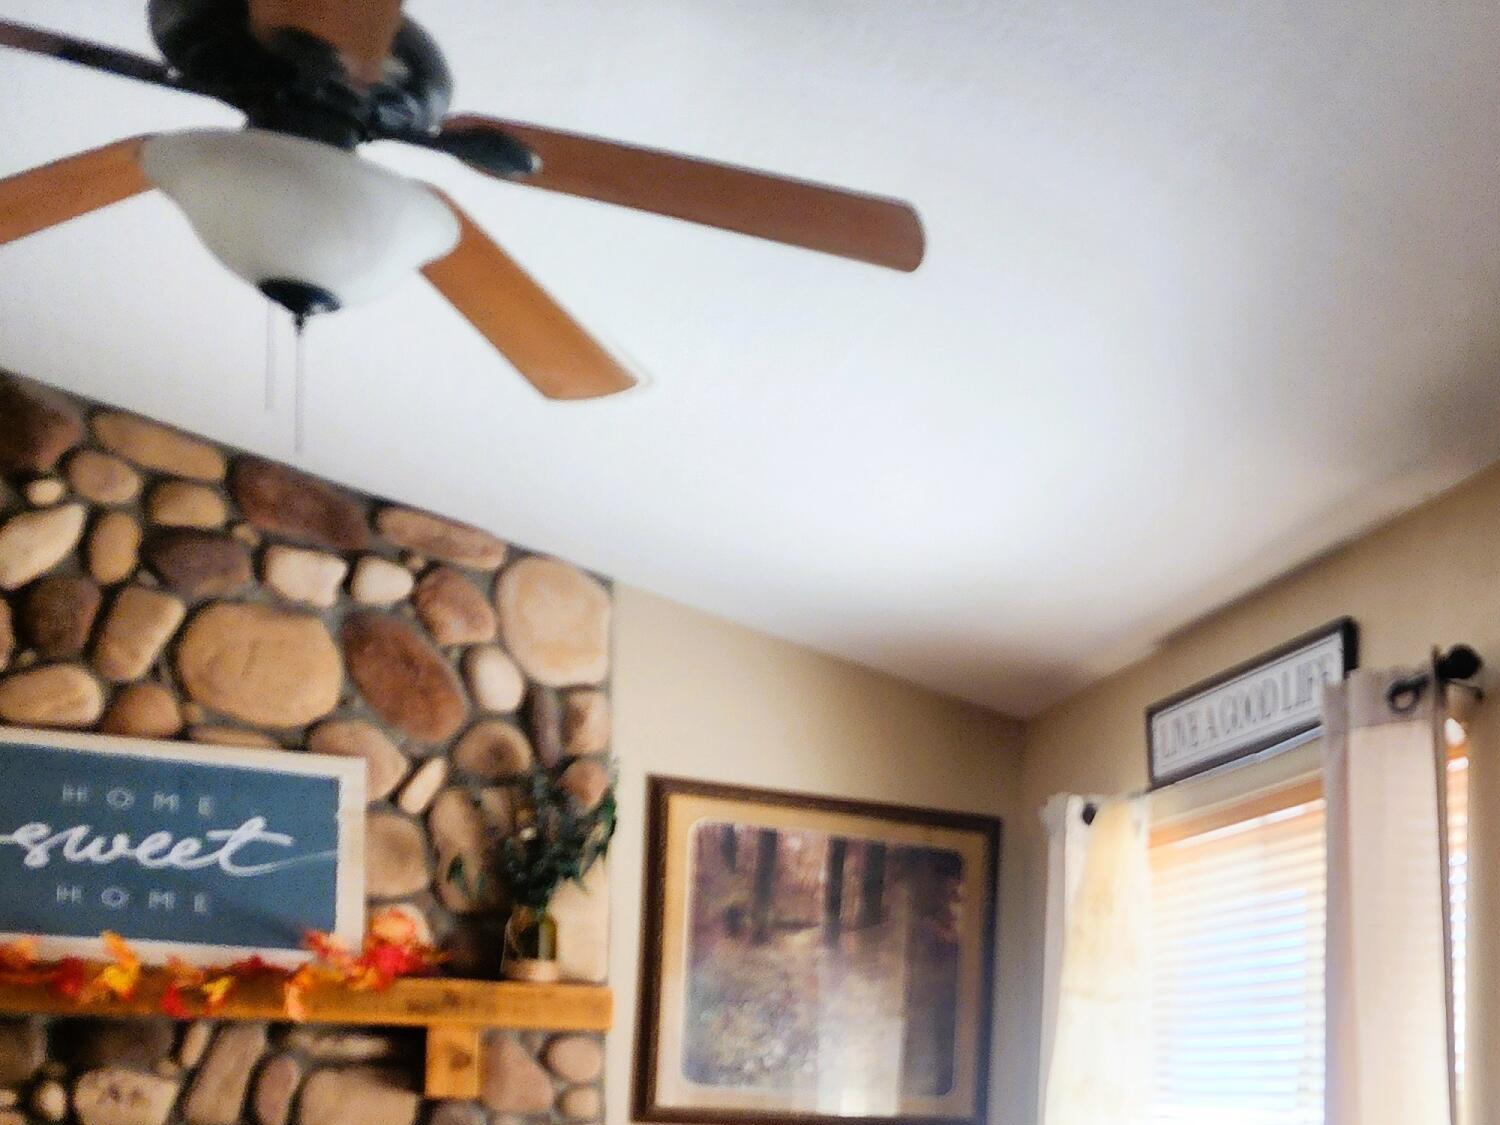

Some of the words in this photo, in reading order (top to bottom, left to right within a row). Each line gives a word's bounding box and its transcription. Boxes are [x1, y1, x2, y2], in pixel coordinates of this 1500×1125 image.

[1219, 677, 1280, 736] GOOD
[62, 783, 215, 817] HOME
[0, 816, 337, 877] sweet
[56, 884, 209, 914] HOME
